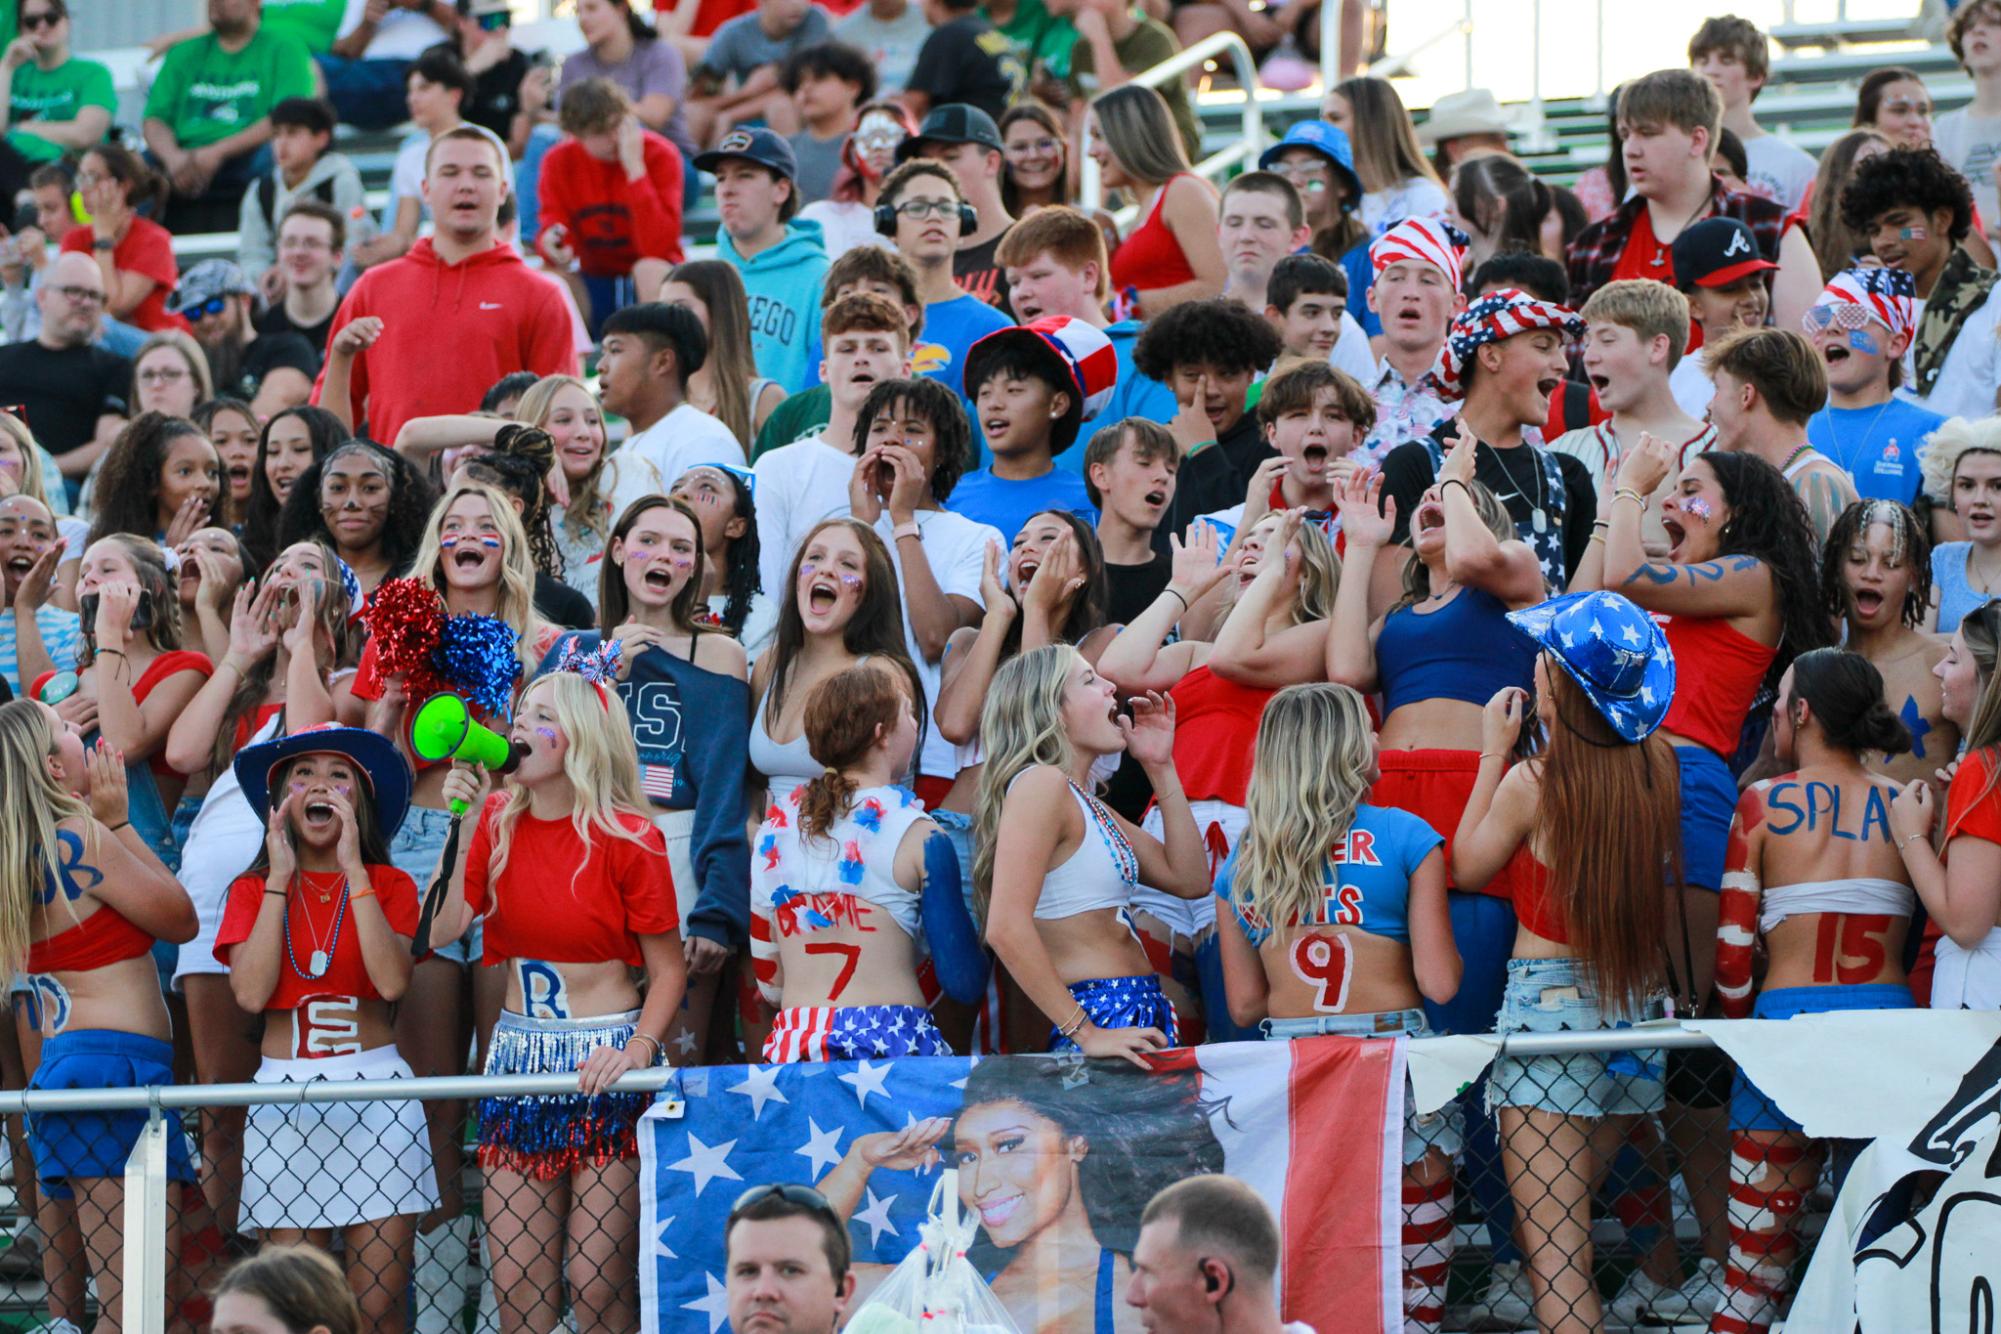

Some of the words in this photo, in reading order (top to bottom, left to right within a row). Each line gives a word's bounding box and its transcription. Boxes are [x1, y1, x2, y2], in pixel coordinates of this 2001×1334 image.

[1724, 229, 1750, 257] A
[747, 296, 796, 347] EGO
[1766, 781, 1899, 844] SPLA
[804, 942, 862, 1002] 7
[1289, 932, 1353, 1014] 9
[1813, 911, 1892, 985] 15
[516, 957, 572, 1020] R
[292, 992, 362, 1060] E
